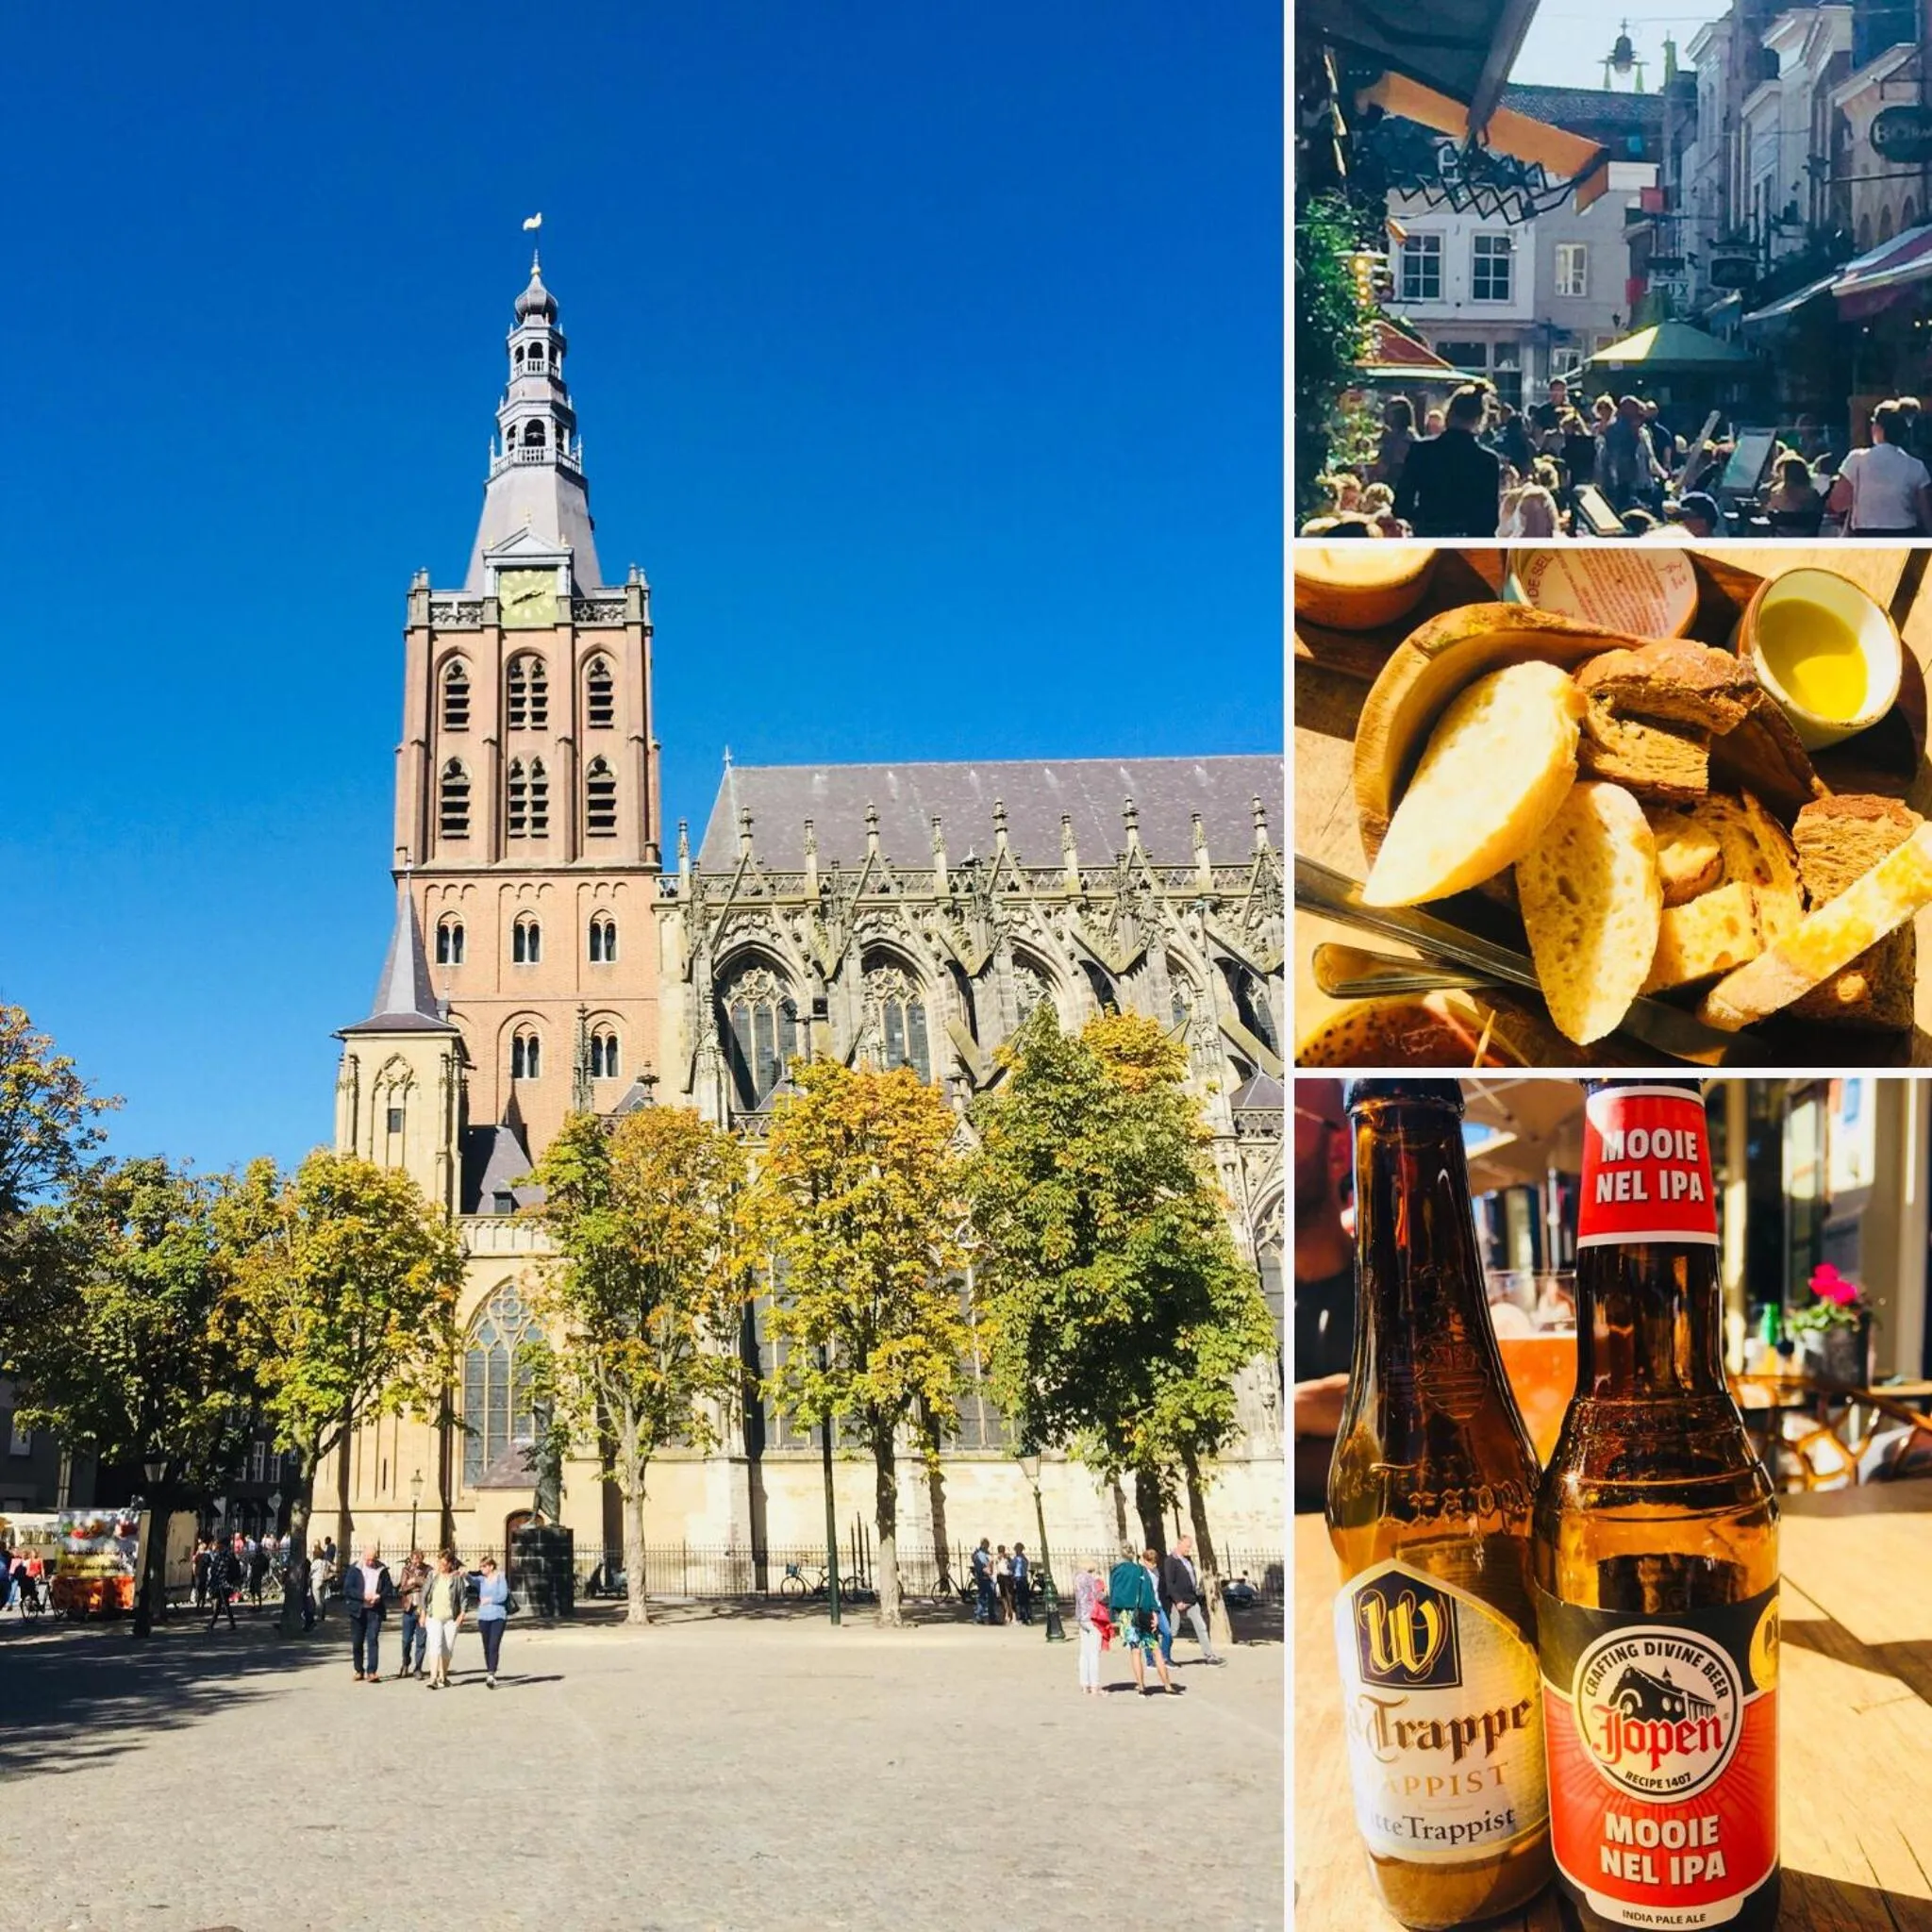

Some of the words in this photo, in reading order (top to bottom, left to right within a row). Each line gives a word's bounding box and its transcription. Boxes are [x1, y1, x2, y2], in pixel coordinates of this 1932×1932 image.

[1602, 1128, 1699, 1163] MOOIE
[1596, 1170, 1648, 1204] NEL
[1659, 1170, 1705, 1202] IPA
[1585, 1643, 1640, 1698] CRAFTING
[1643, 1641, 1705, 1670] DIVINE
[1701, 1662, 1729, 1700] BEER
[1358, 1694, 1532, 1764] Trappe
[1591, 1705, 1724, 1772] Jopen
[1625, 1772, 1663, 1789] RECIPE
[1666, 1773, 1690, 1789] 1407
[1403, 1807, 1515, 1845] Trappist
[1605, 1812, 1720, 1849] MOOIE
[1600, 1845, 1659, 1885] NEL
[1670, 1851, 1726, 1885] IPA
[1623, 1909, 1654, 1924] INDIA
[1656, 1916, 1683, 1925] PALE
[1685, 1913, 1707, 1924] ALE
